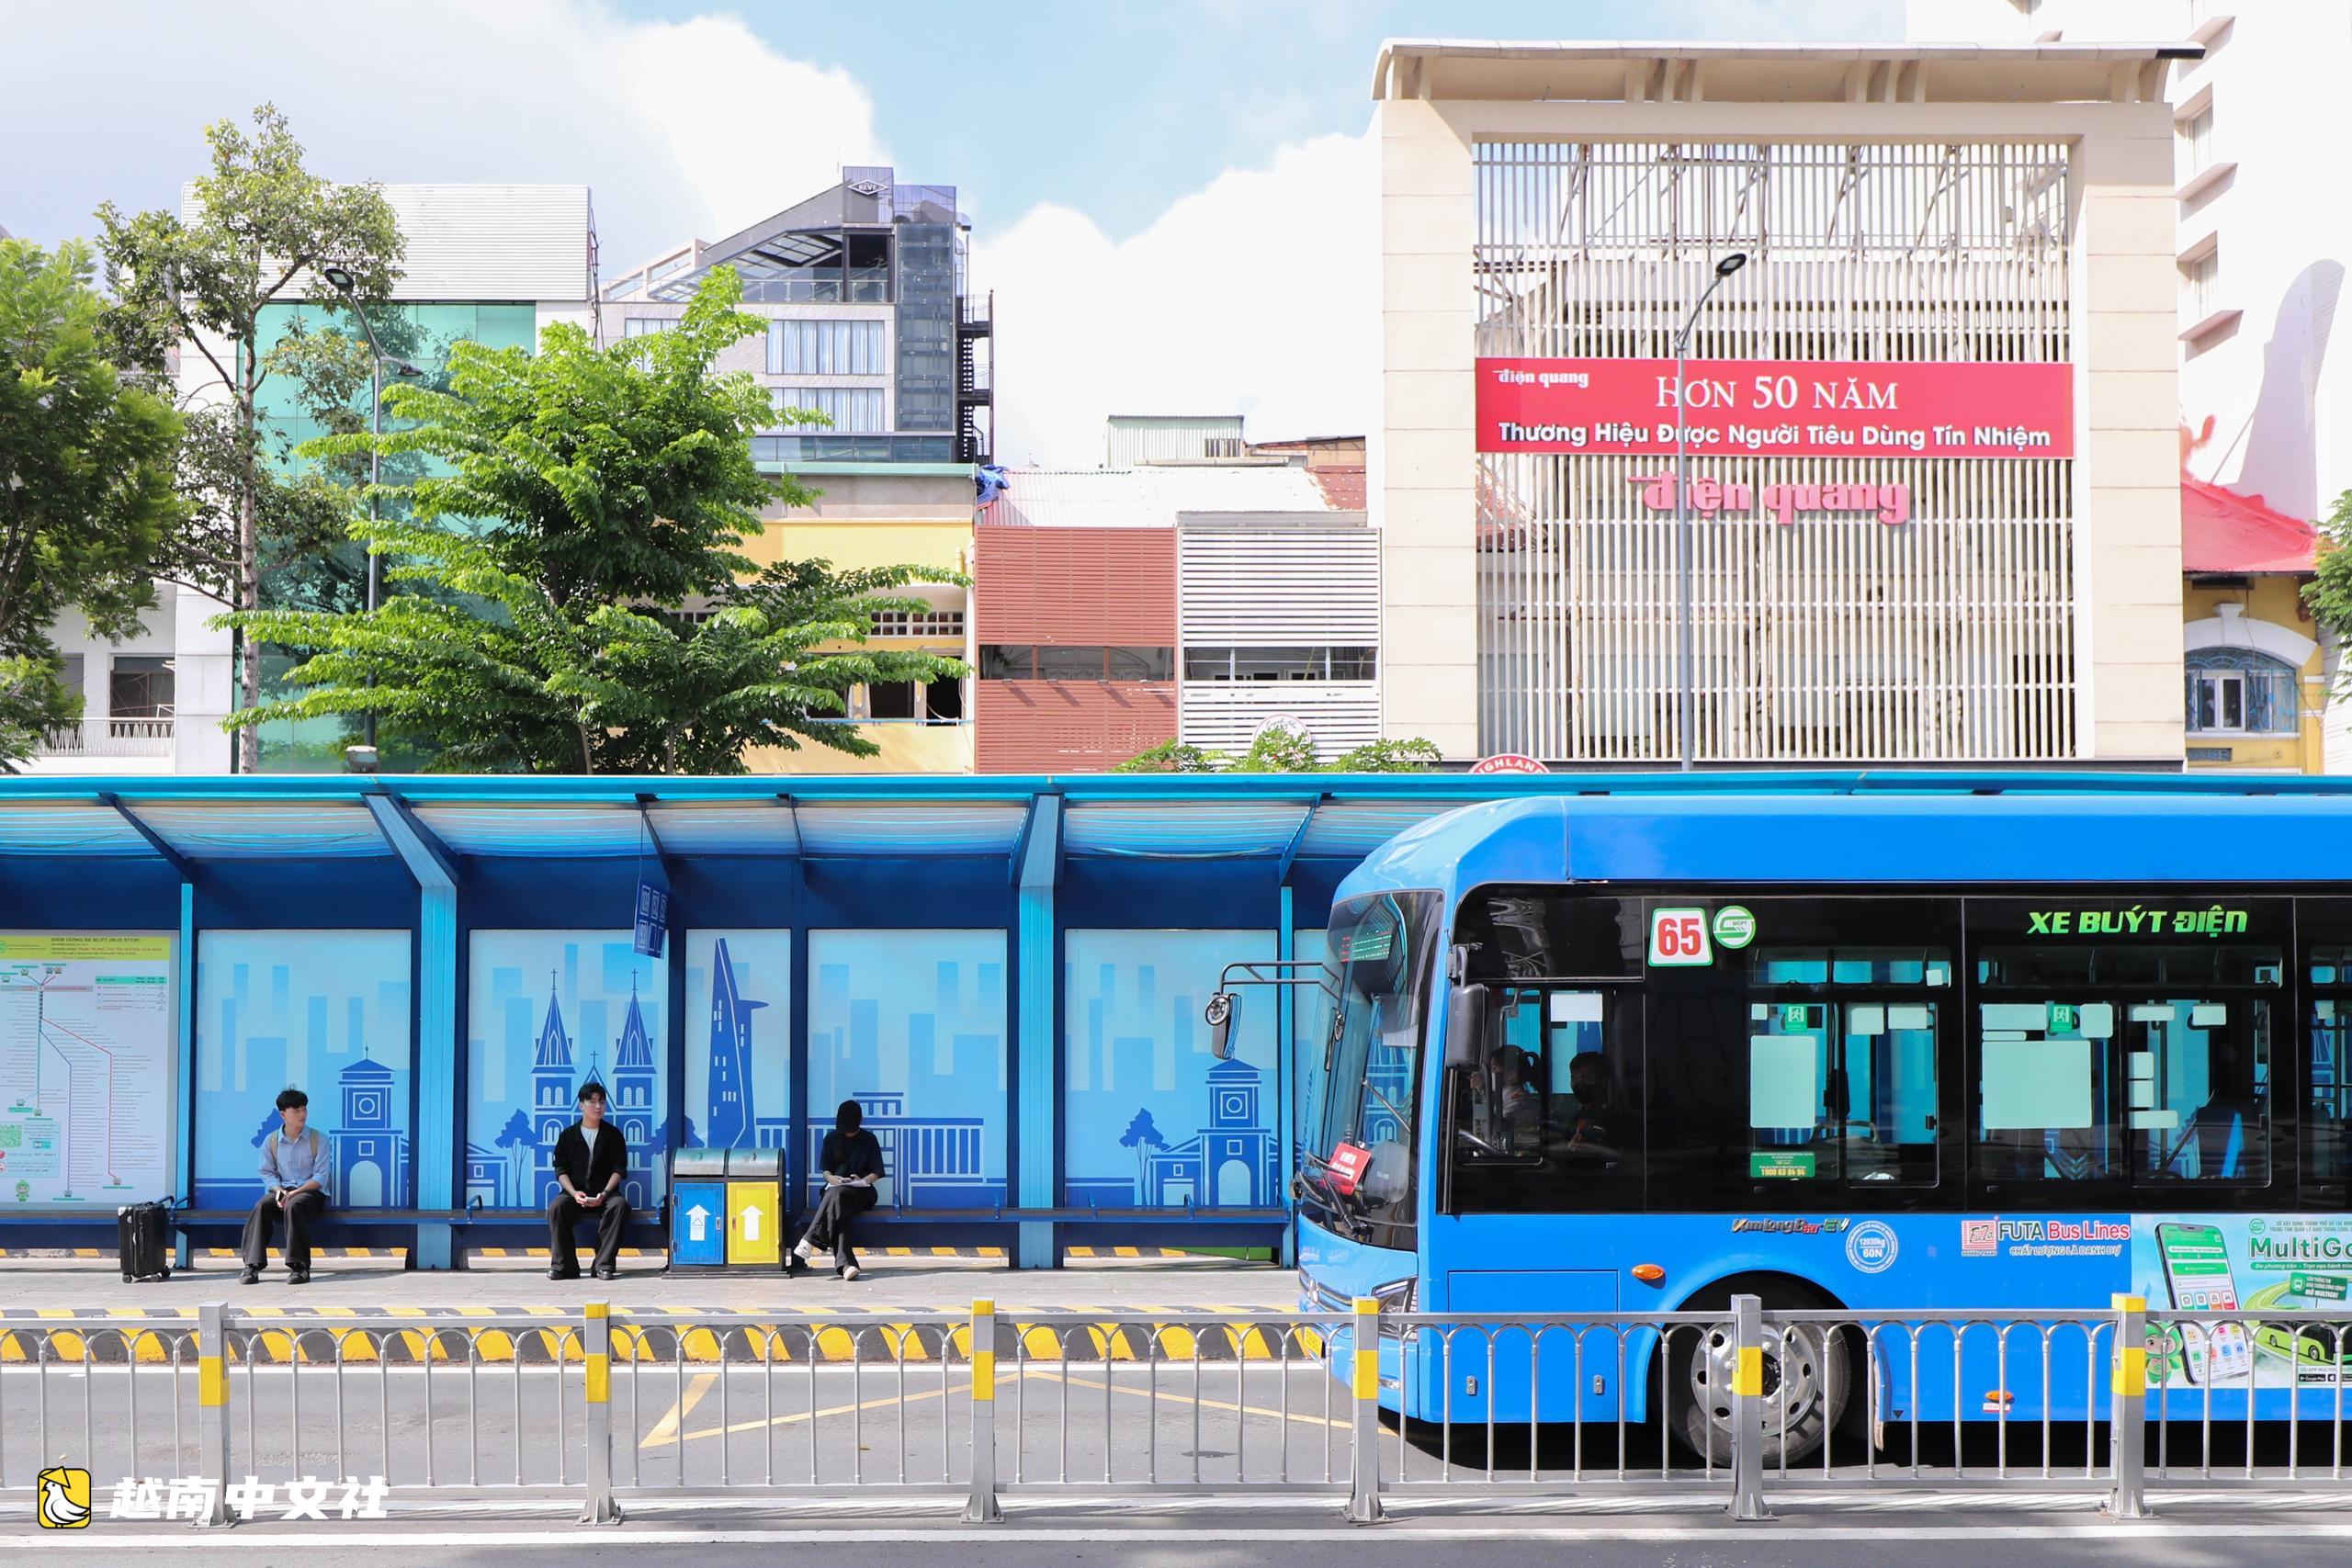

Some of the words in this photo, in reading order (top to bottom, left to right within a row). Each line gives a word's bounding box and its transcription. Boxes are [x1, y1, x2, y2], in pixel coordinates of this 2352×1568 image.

[1538, 372, 1589, 388] quang
[1656, 376, 1736, 408] HƠN
[1752, 374, 1798, 410] 50
[1813, 377, 1898, 410] NĂM
[1498, 422, 1588, 446] Thương
[1595, 423, 1649, 446] Hiệu
[1657, 423, 1721, 448] Được
[1728, 423, 1799, 447] Người
[1806, 424, 1855, 446] Tiêu
[1862, 424, 1926, 451] Dùng
[1932, 424, 1966, 446] Tín
[1973, 426, 2051, 452] Nhiệm
[1762, 483, 1910, 525] quang
[2027, 911, 2071, 934] XE
[2078, 905, 2167, 933] BUÝT
[1657, 918, 1702, 956] 65
[1998, 1221, 2043, 1240] FUTA
[2048, 1221, 2080, 1240] Bus
[2083, 1220, 2131, 1240] Lines
[1862, 1248, 1883, 1258] 60N
[2009, 1244, 2033, 1256] CHẤT
[2065, 1245, 2078, 1256] LÀ
